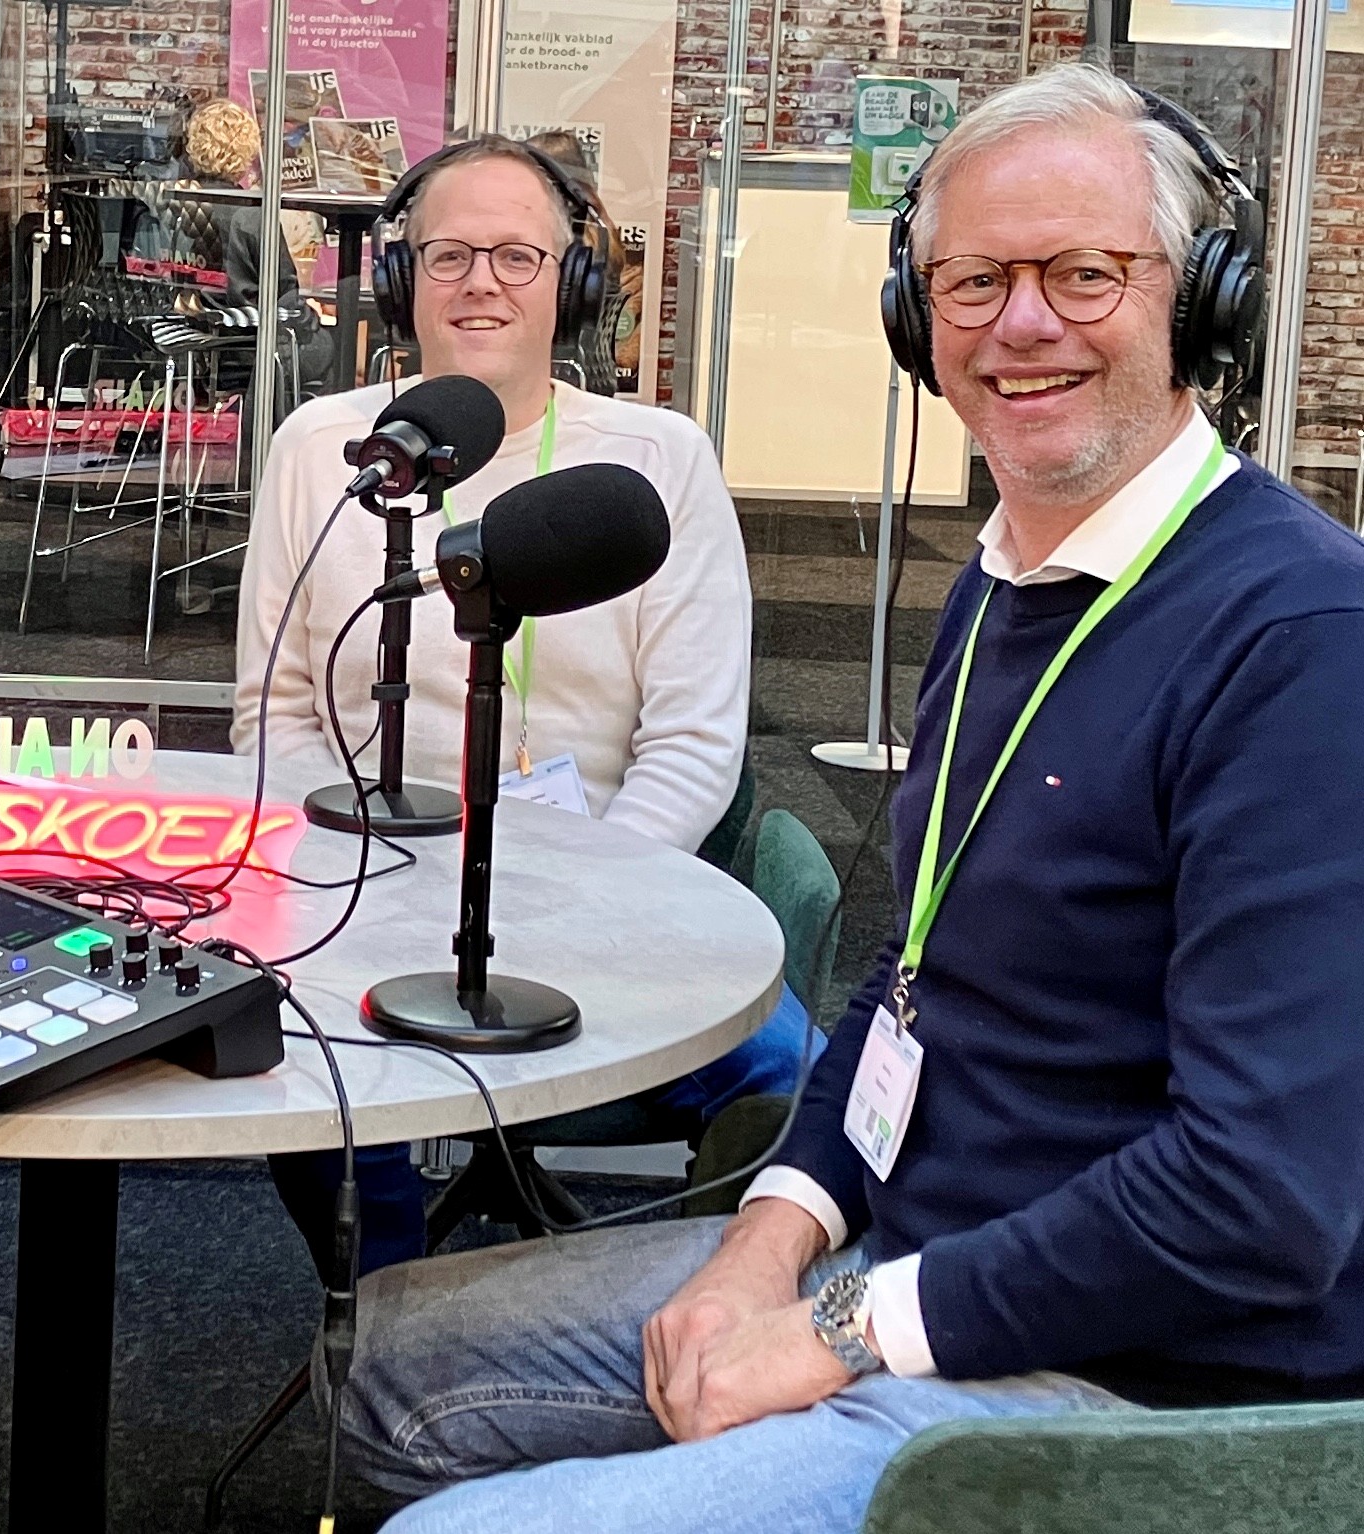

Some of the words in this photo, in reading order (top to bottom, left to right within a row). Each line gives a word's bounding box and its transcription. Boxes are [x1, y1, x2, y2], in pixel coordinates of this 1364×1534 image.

[308, 13, 394, 26] onafhankelijke
[310, 27, 337, 36] voor
[340, 26, 417, 38] professionals
[297, 36, 309, 47] in
[311, 38, 327, 47] de
[506, 31, 561, 44] hankelijk
[564, 33, 613, 45] vakblad
[519, 46, 535, 55] de
[538, 46, 581, 57] brood-
[585, 49, 600, 57] en
[505, 61, 589, 71] anketbranche
